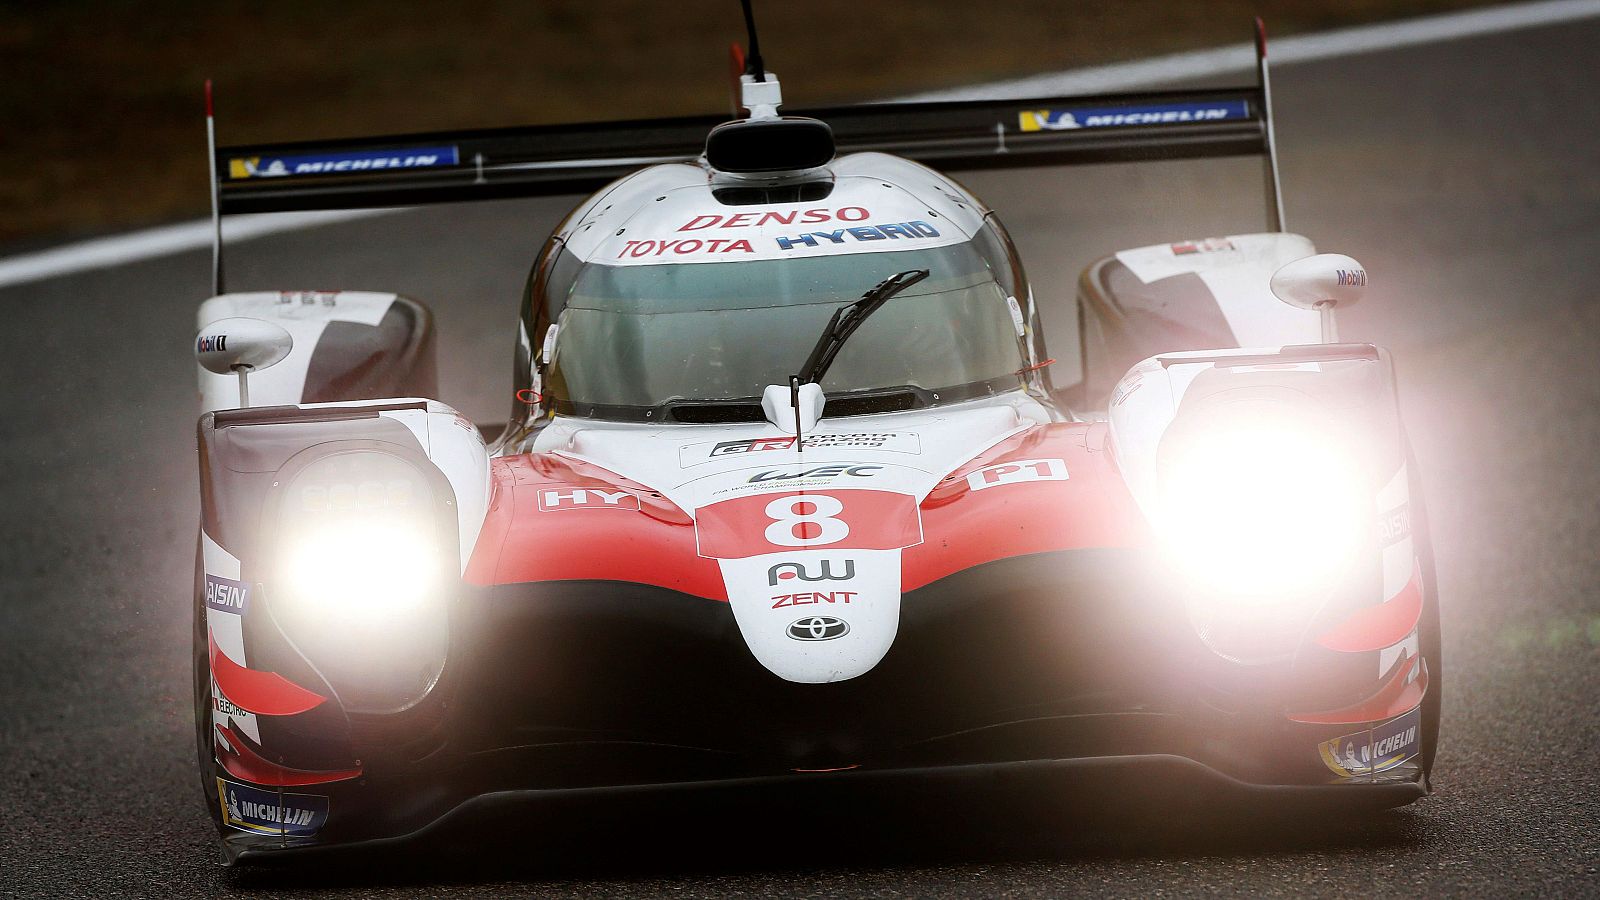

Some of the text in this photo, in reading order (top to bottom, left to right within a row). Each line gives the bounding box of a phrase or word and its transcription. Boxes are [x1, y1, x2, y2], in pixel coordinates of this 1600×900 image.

[1086, 109, 1228, 126] MICHELIN
[296, 155, 437, 173] MICHELIN
[676, 206, 870, 232] DENSO
[775, 220, 941, 250] HYBRID
[617, 239, 755, 258] TOYOTA
[1336, 269, 1360, 286] Mobil
[709, 436, 797, 457] GR
[748, 465, 884, 483] WEC
[982, 462, 1052, 483] P1
[545, 489, 633, 507] HY
[764, 494, 849, 546] 8
[1377, 509, 1410, 539] AISIN
[207, 581, 246, 608] AISIN
[771, 591, 858, 609] ZENT
[1361, 726, 1416, 762] MICHELIN
[242, 801, 315, 826] MICHELIN
